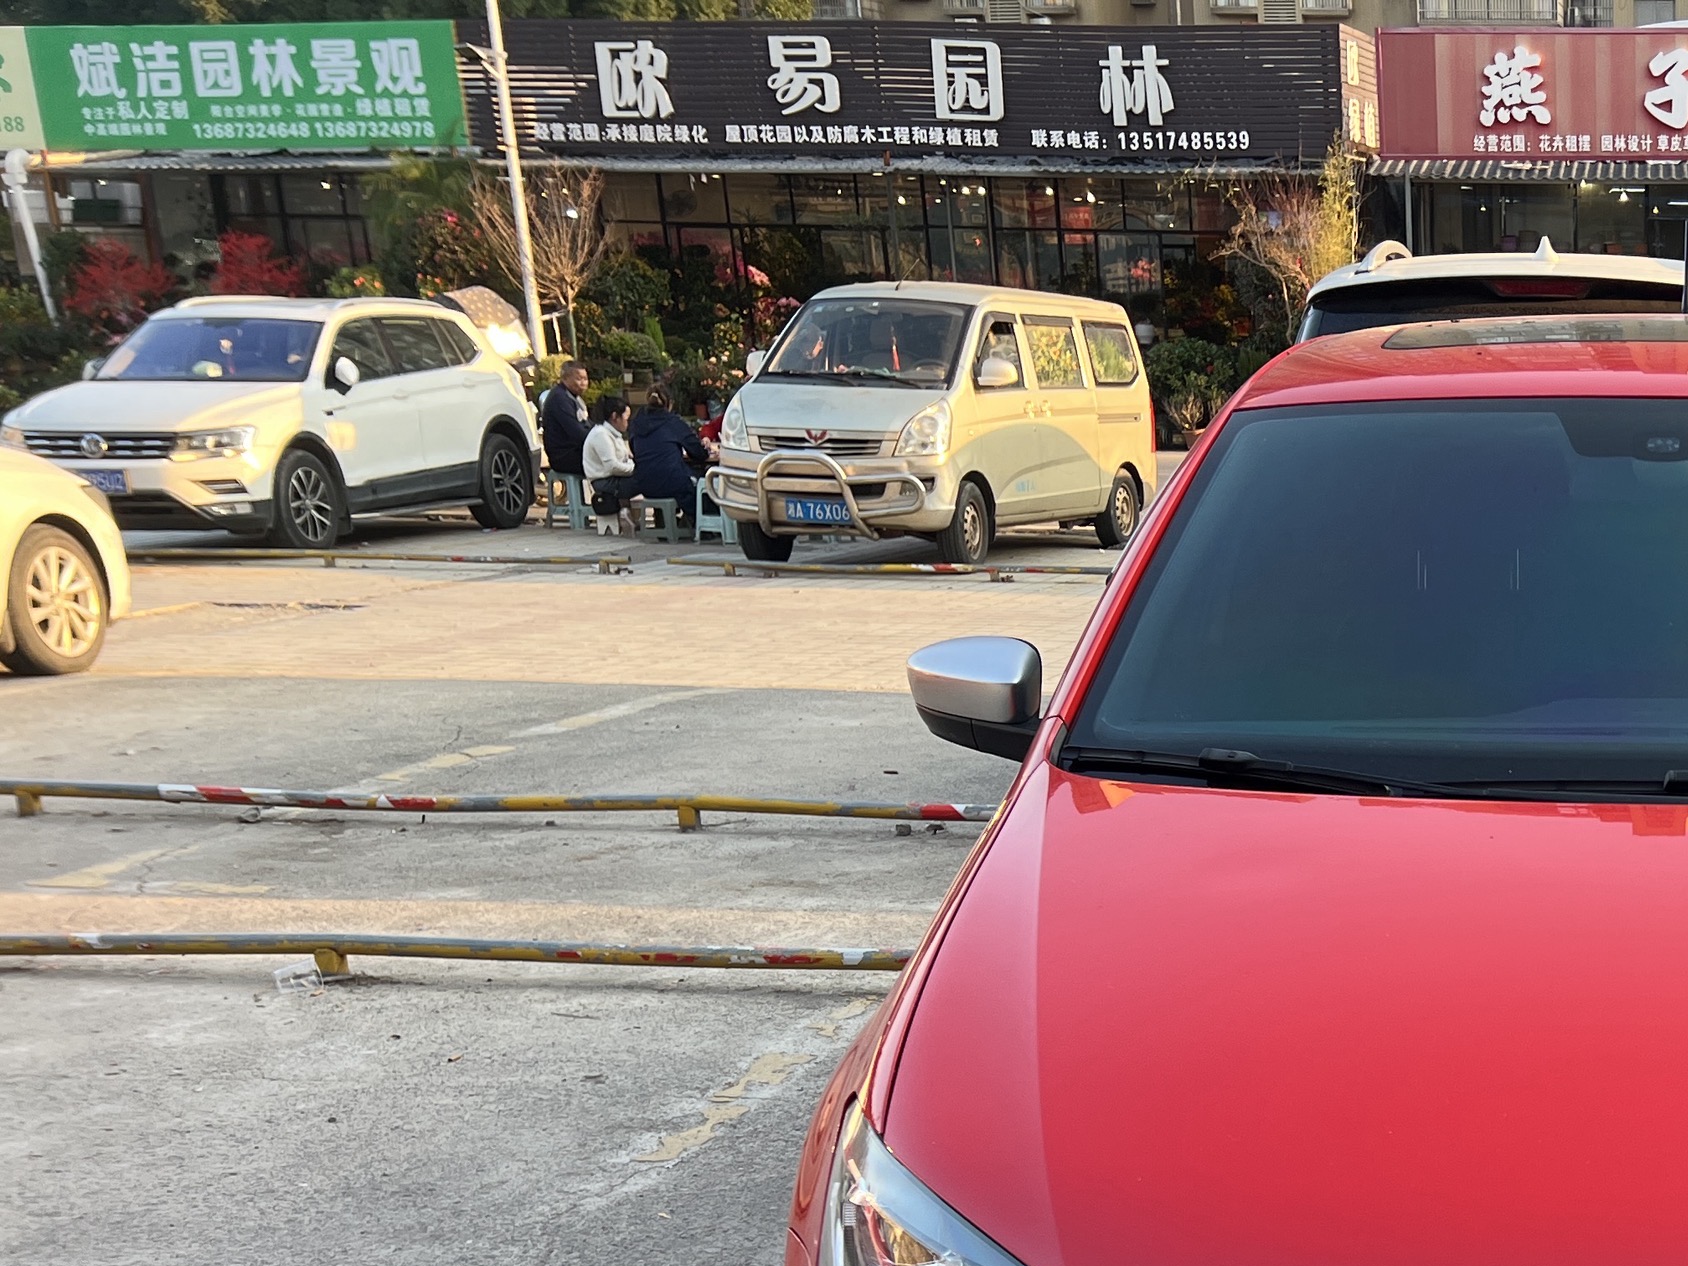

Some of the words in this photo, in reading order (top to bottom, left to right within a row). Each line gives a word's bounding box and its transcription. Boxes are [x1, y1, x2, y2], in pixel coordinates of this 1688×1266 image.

[69, 38, 427, 99] 斌洁园林景观
[594, 35, 1174, 127] 欧易园林
[192, 121, 311, 138] 13687324648
[314, 122, 436, 138] 13687324978
[1117, 130, 1250, 151] 13517485539
